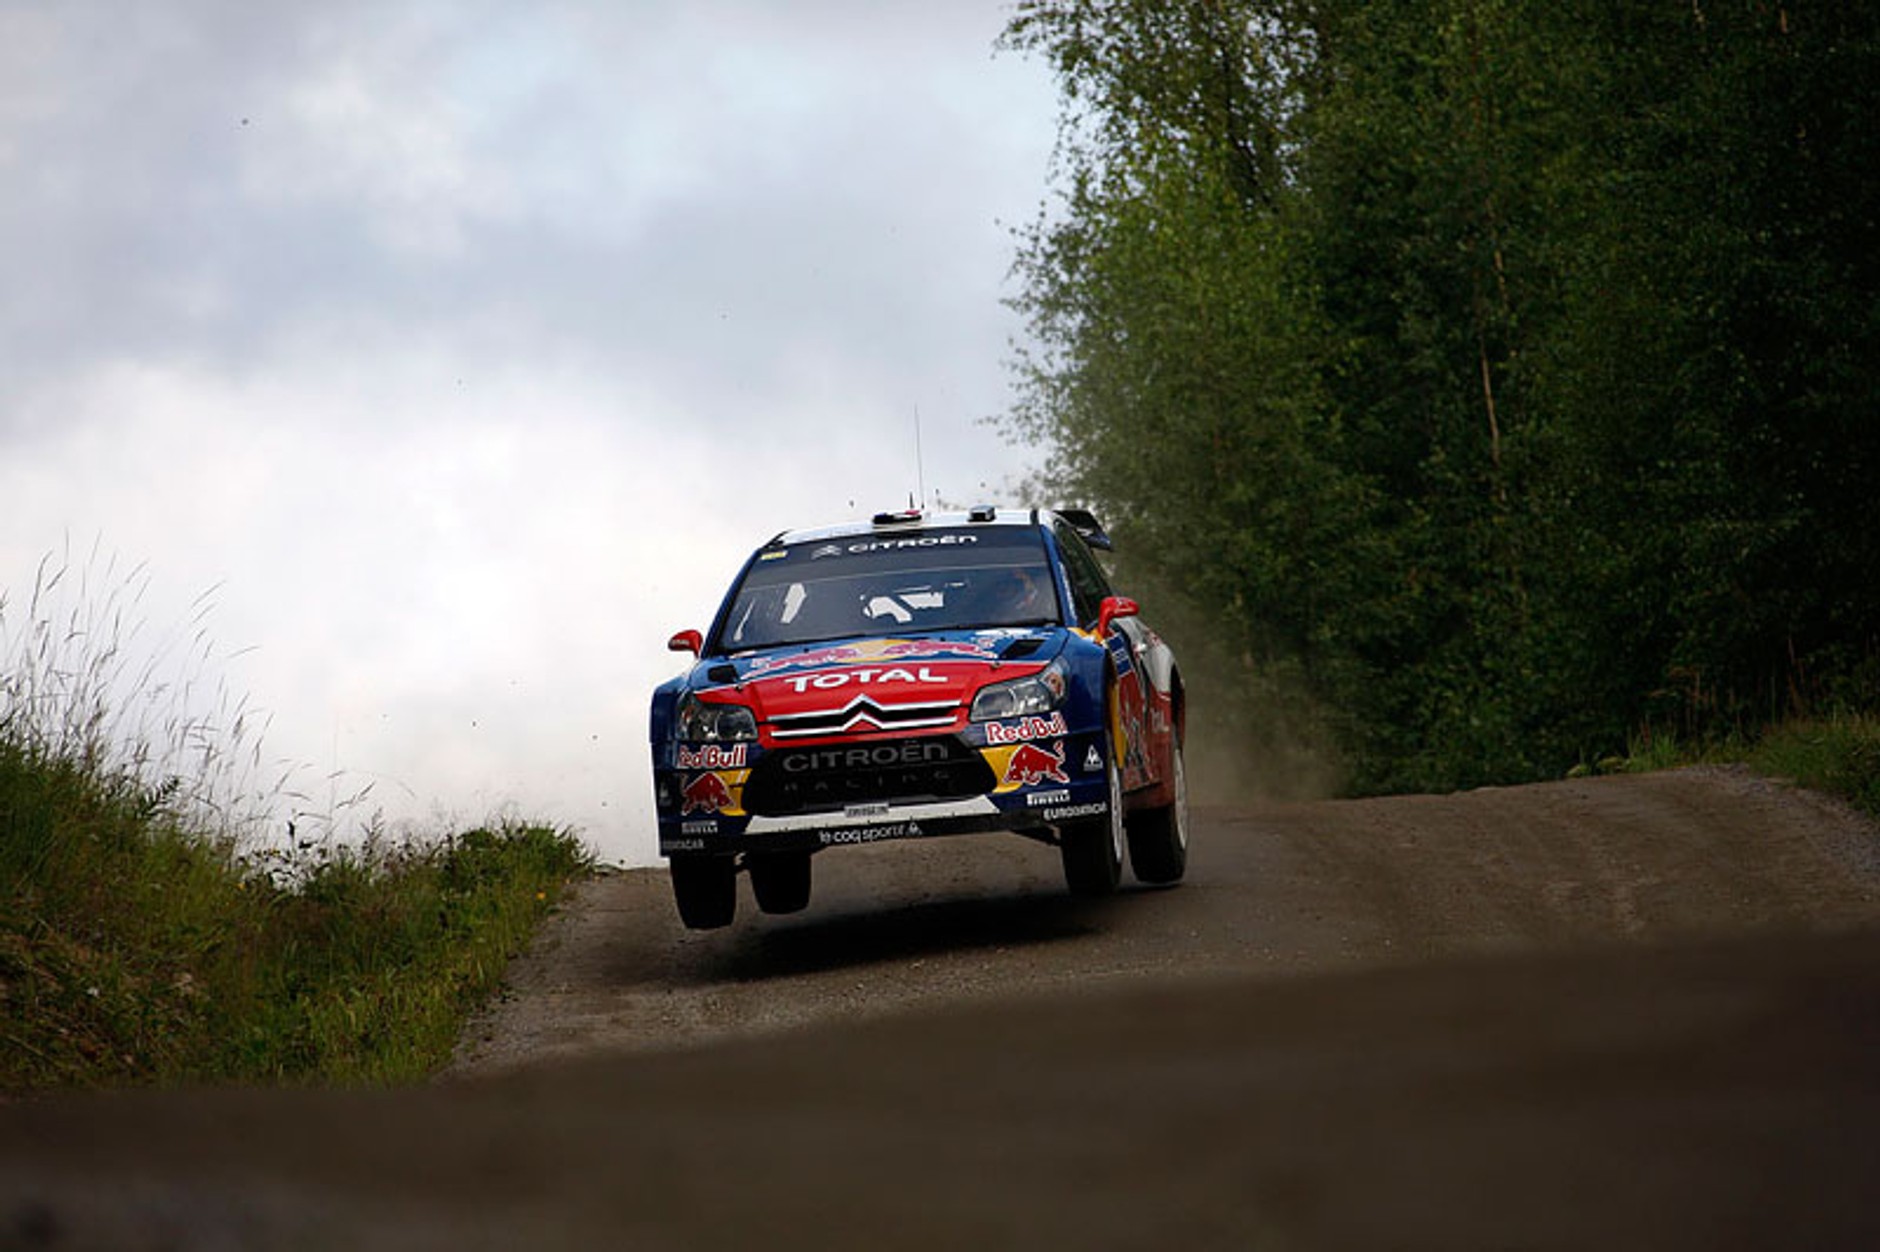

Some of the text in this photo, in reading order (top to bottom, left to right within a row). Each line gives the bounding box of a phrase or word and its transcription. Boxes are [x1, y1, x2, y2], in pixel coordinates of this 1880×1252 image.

[783, 667, 949, 693] TOTAL
[985, 711, 1068, 744] Red Bull
[706, 742, 747, 768] Bull
[833, 829, 861, 844] coq
